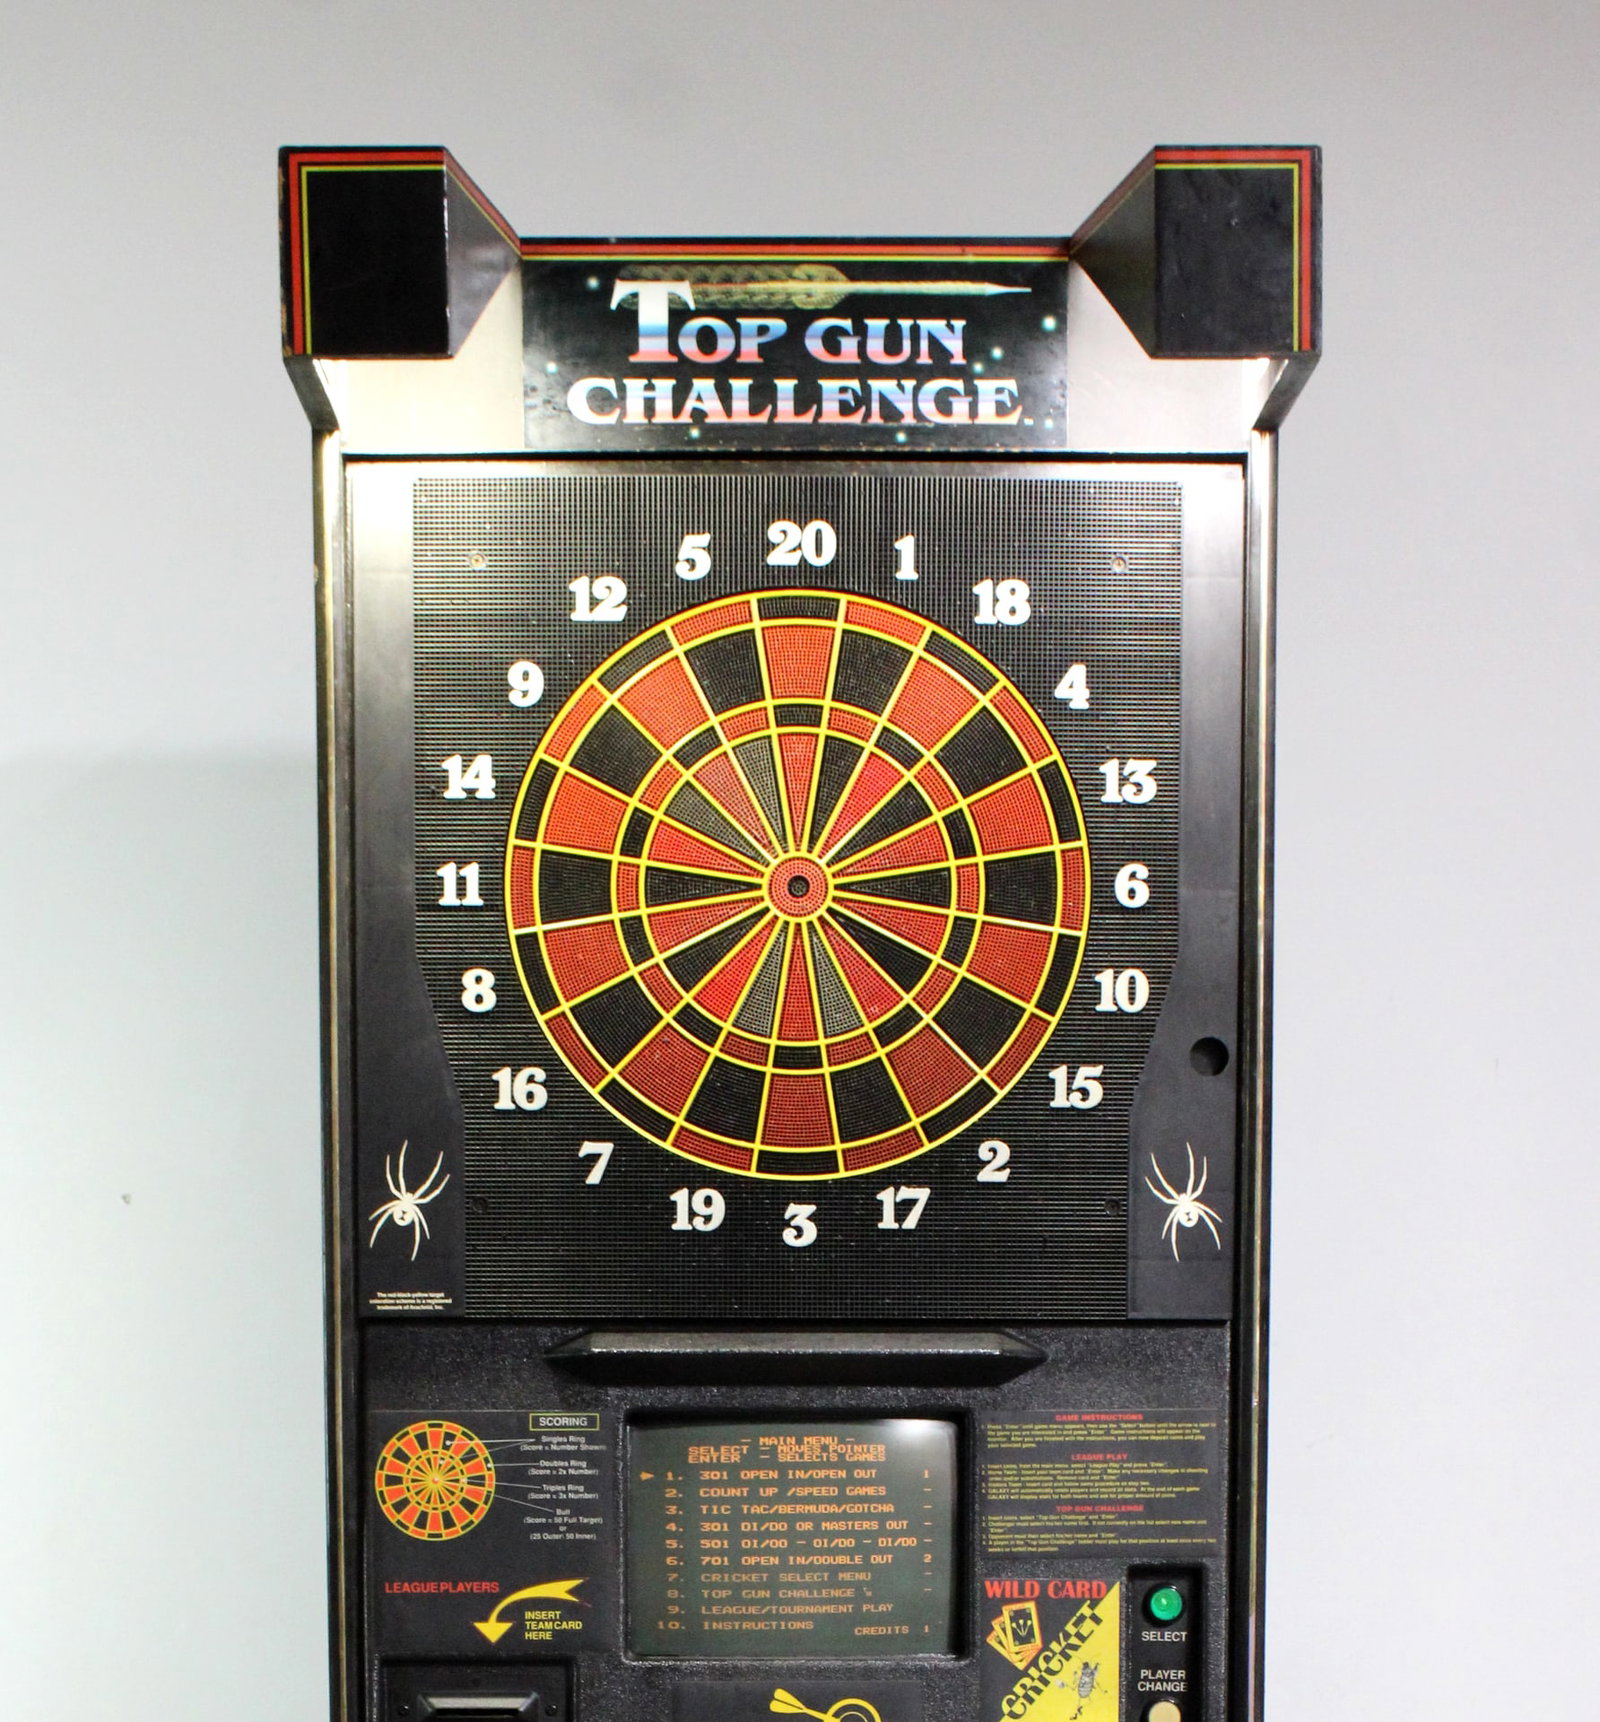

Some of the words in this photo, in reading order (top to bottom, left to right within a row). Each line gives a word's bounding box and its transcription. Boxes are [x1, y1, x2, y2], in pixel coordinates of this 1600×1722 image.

[610, 279, 788, 363] TOP
[804, 317, 968, 365] GUN
[566, 377, 1023, 425] CHALLENGE
[766, 520, 837, 567] 20
[676, 533, 712, 581] 5
[894, 536, 919, 581] 1
[568, 575, 629, 623] 12
[972, 578, 1031, 625] 18
[507, 661, 545, 707] 9
[1054, 664, 1089, 709] 4
[441, 754, 496, 800] 14
[1099, 758, 1158, 804] 13
[436, 863, 484, 907] 11
[1113, 864, 1150, 908] 6
[461, 967, 497, 1012] 8
[1094, 968, 1150, 1013] 10
[492, 1067, 547, 1111] 16
[1049, 1065, 1104, 1109] 15
[578, 1141, 614, 1185] 7
[977, 1140, 1011, 1184] 2
[670, 1188, 726, 1232] 19
[877, 1187, 931, 1231] 17
[782, 1203, 817, 1248] 3
[539, 1417, 588, 1426] SCORING
[569, 1435, 586, 1444] Ring
[759, 1436, 796, 1445] MAIN
[804, 1436, 838, 1445] MENU
[688, 1446, 749, 1455] SELECT
[778, 1445, 820, 1454] MOVES
[829, 1444, 886, 1454] POINTER
[570, 1460, 587, 1468] Ring
[688, 1454, 741, 1463] ENTER
[778, 1453, 838, 1462] SELECTS
[846, 1453, 886, 1462] GAMES
[666, 1471, 683, 1480] 1.
[700, 1471, 729, 1480] 301
[740, 1470, 778, 1479] OPEN
[788, 1469, 846, 1479] IN/OPEN
[854, 1469, 877, 1478] OUT
[567, 1484, 584, 1492] Ring
[665, 1488, 683, 1498] 2.
[699, 1488, 749, 1497] COUNT
[759, 1487, 778, 1497] UP
[846, 1487, 886, 1496] GAMES
[665, 1505, 683, 1515] 3.
[700, 1505, 731, 1514] TIC
[742, 1504, 894, 1514] TAC/BERMUDA/GOTCHA
[665, 1522, 683, 1532] 4.
[700, 1522, 729, 1531] 301
[796, 1521, 813, 1531] OR
[822, 1521, 879, 1530] MASTERS
[886, 1520, 909, 1530] OUT
[665, 1539, 684, 1549] 5.
[700, 1539, 729, 1548] 501
[666, 1556, 684, 1566] 6.
[700, 1556, 729, 1565] 701
[741, 1556, 779, 1565] OPEN
[870, 1554, 893, 1564] OUT
[923, 1553, 932, 1563] 2
[667, 1574, 684, 1582] 7.
[701, 1573, 769, 1582] CRICKET
[779, 1572, 830, 1582] SELECT
[838, 1572, 871, 1581] MENU
[385, 1582, 440, 1593] LEAGUE
[440, 1582, 500, 1593] PLAYERS
[667, 1590, 685, 1599] 8.
[701, 1590, 732, 1598] TOP
[742, 1590, 771, 1598] GUN
[779, 1588, 855, 1598] CHALLENGE
[984, 1580, 1040, 1599] WILD
[1048, 1580, 1107, 1599] CARD
[667, 1606, 685, 1614] 9.
[701, 1604, 854, 1614] LEAGUE/TOURNAMENT
[862, 1603, 893, 1613] PLAY
[525, 1611, 561, 1620] INSERT
[525, 1621, 553, 1630] TEAM
[554, 1621, 583, 1630] CARD
[703, 1621, 814, 1630] INSTRUCTIONS
[854, 1625, 910, 1635] CREDITS
[525, 1631, 553, 1640] HERE
[1141, 1631, 1188, 1641] SELECT
[1001, 1600, 1103, 1720] CRICKET
[1140, 1669, 1186, 1680] PLAYER
[1138, 1681, 1188, 1692] CHANGE
